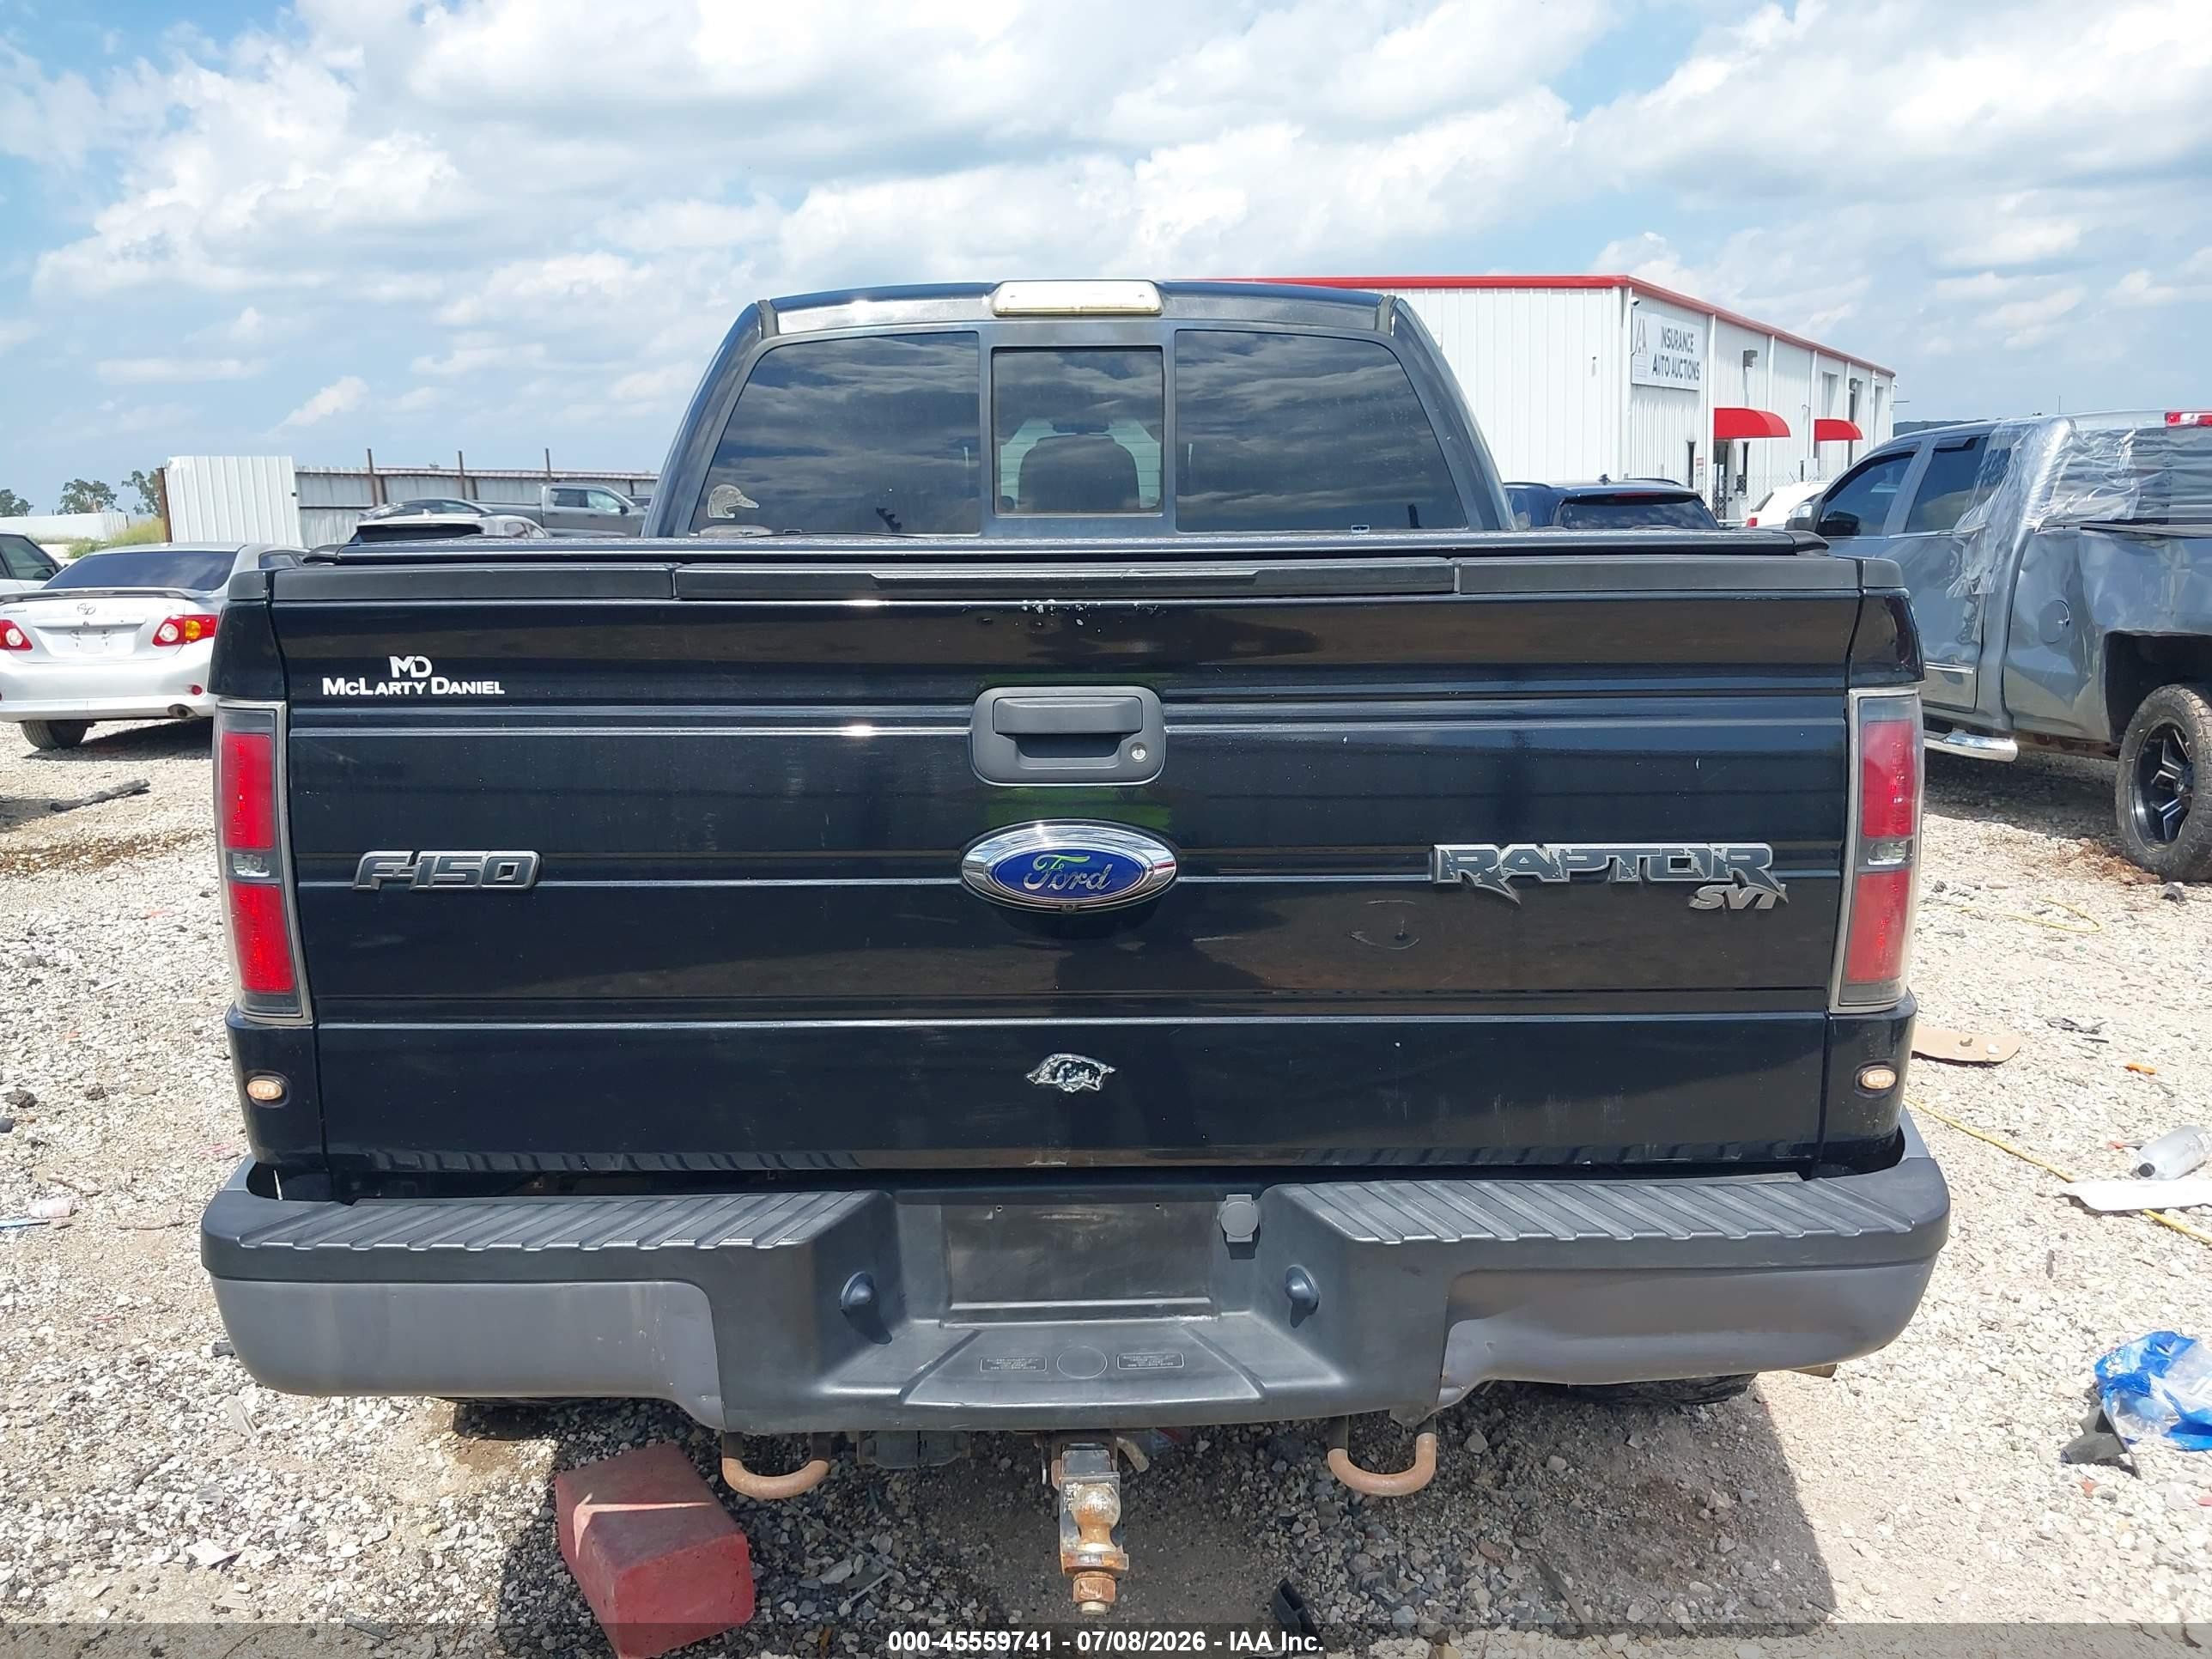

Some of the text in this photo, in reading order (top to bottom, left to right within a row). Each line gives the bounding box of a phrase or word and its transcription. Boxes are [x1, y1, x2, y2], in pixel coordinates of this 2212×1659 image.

[1651, 353, 1670, 378] AUTO
[1671, 356, 1700, 382] AUCTIONS
[389, 655, 433, 678] MD
[351, 850, 540, 890] F-150
[1023, 853, 1114, 892] Ford
[1433, 842, 1789, 905] RAPTOR
[1688, 884, 1787, 910] SVT
